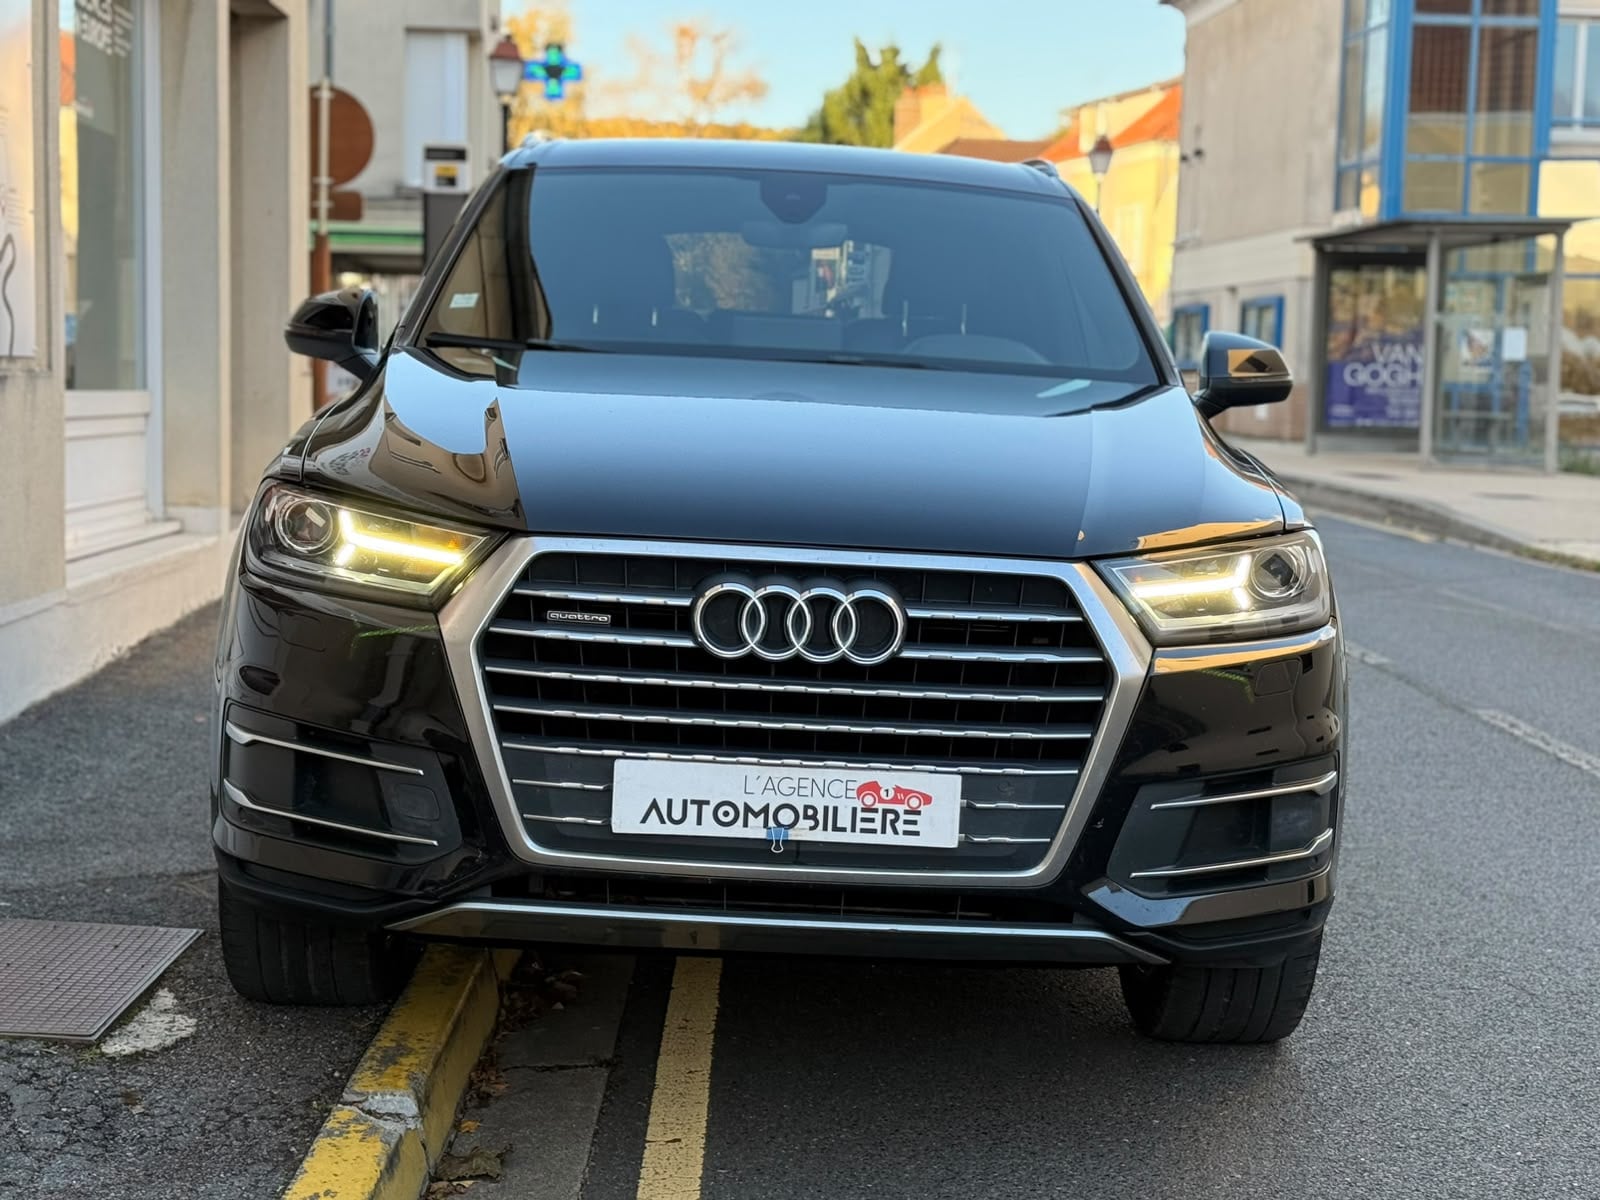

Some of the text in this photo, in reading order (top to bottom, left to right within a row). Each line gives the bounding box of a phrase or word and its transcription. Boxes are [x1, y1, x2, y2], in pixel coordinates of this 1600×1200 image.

[1370, 343, 1423, 364] VAN
[1343, 363, 1423, 387] GOGH
[549, 612, 609, 622] quattro
[743, 774, 857, 800] L'AGENCE
